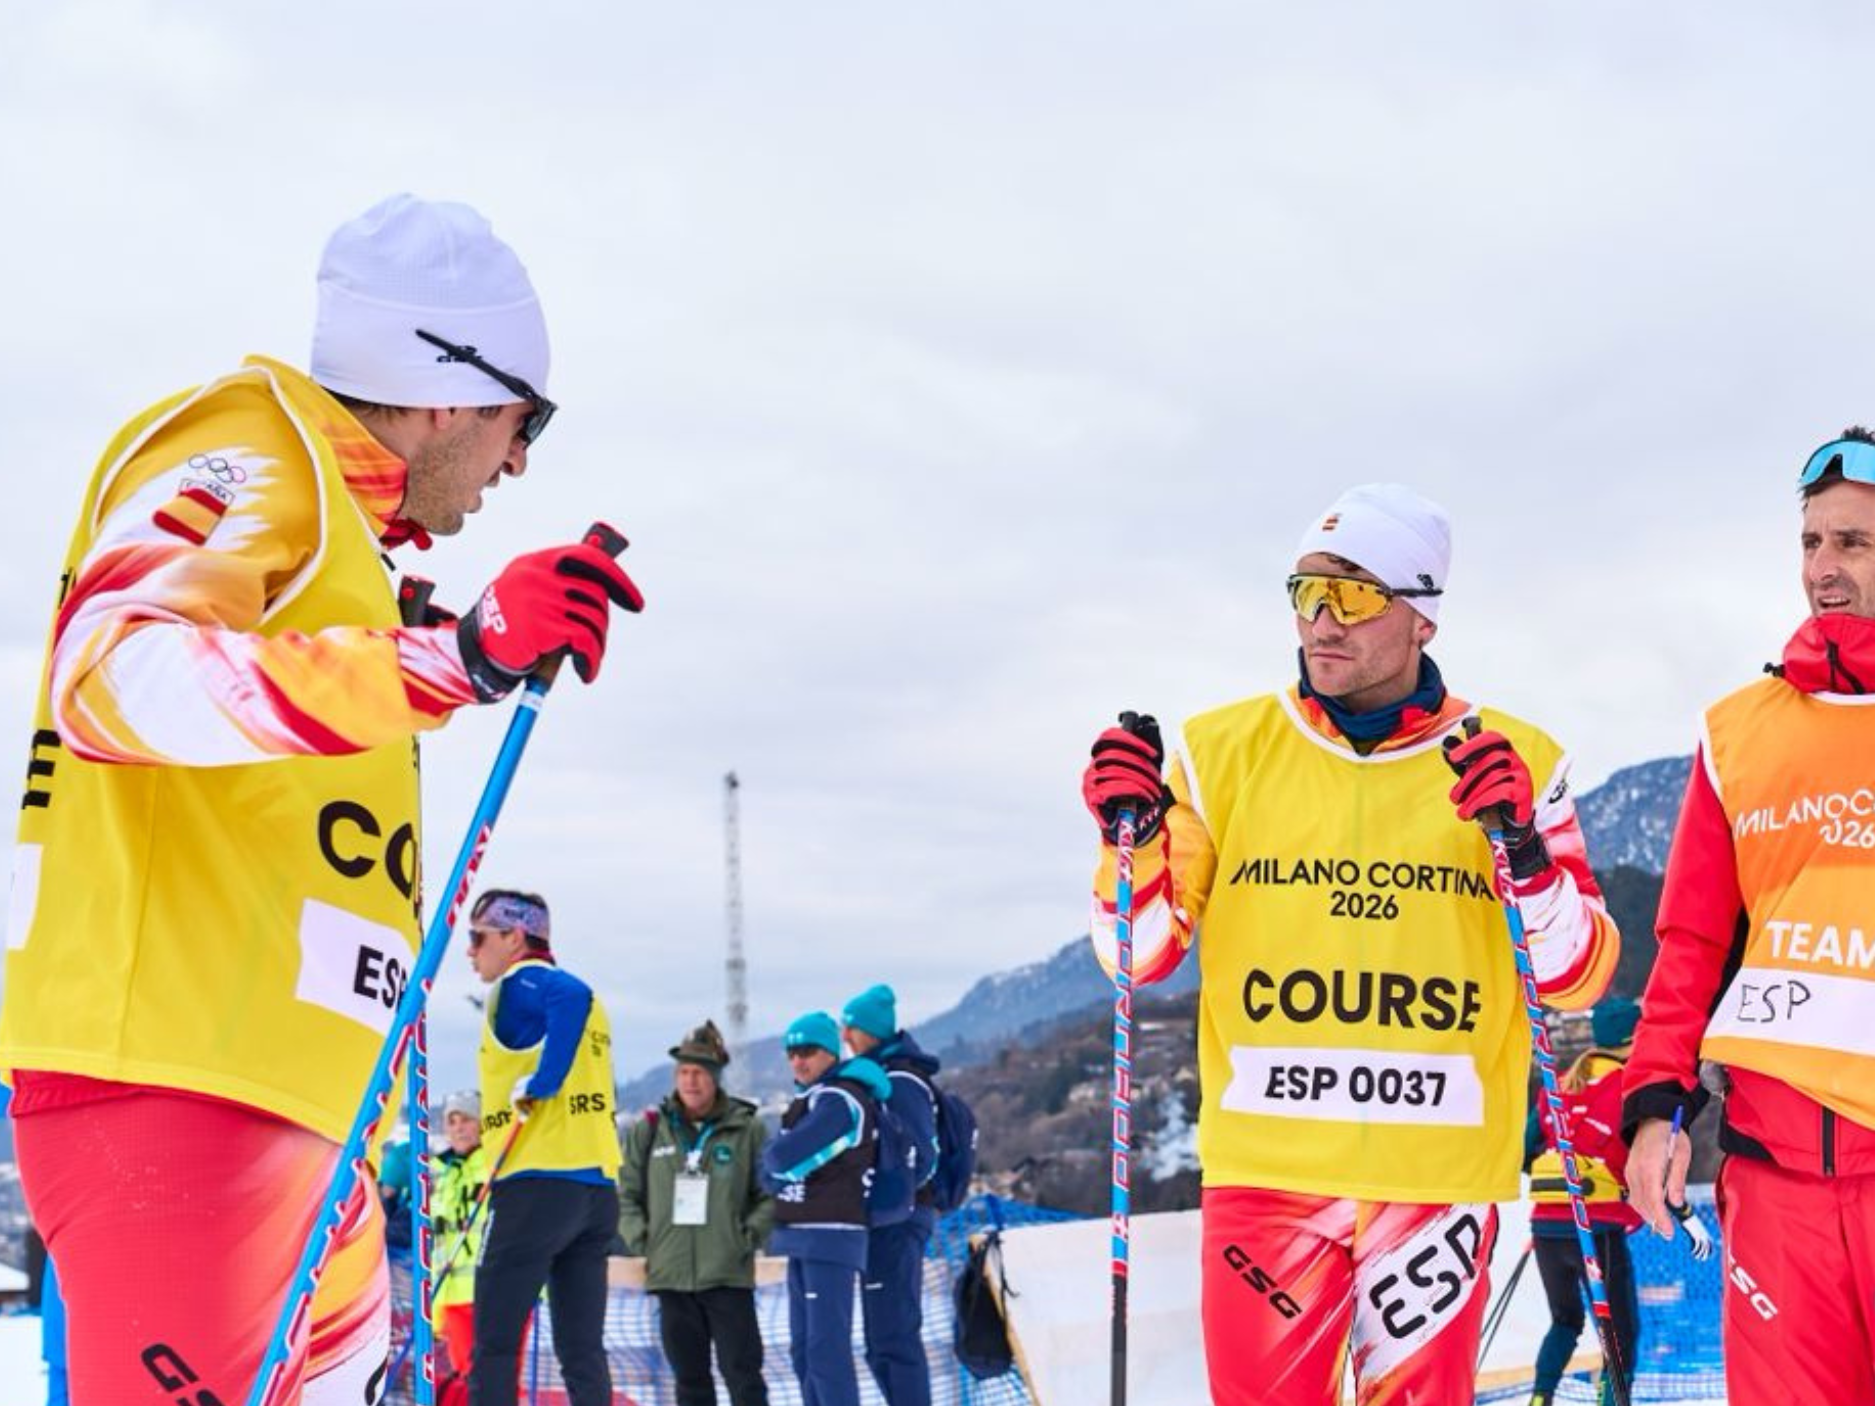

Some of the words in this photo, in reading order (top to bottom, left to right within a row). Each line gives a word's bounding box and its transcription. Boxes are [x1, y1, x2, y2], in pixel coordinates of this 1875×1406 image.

[1230, 858, 1360, 886] MILANO
[1368, 863, 1496, 902] CORTINA
[1330, 891, 1399, 920] 2026
[1243, 969, 1481, 1033] COURSE
[1737, 980, 1812, 1023] ESP
[1265, 1065, 1338, 1101] ESP
[1349, 1066, 1447, 1107] 0037
[1223, 1244, 1303, 1320] GSG
[1368, 1213, 1482, 1339] ESP
